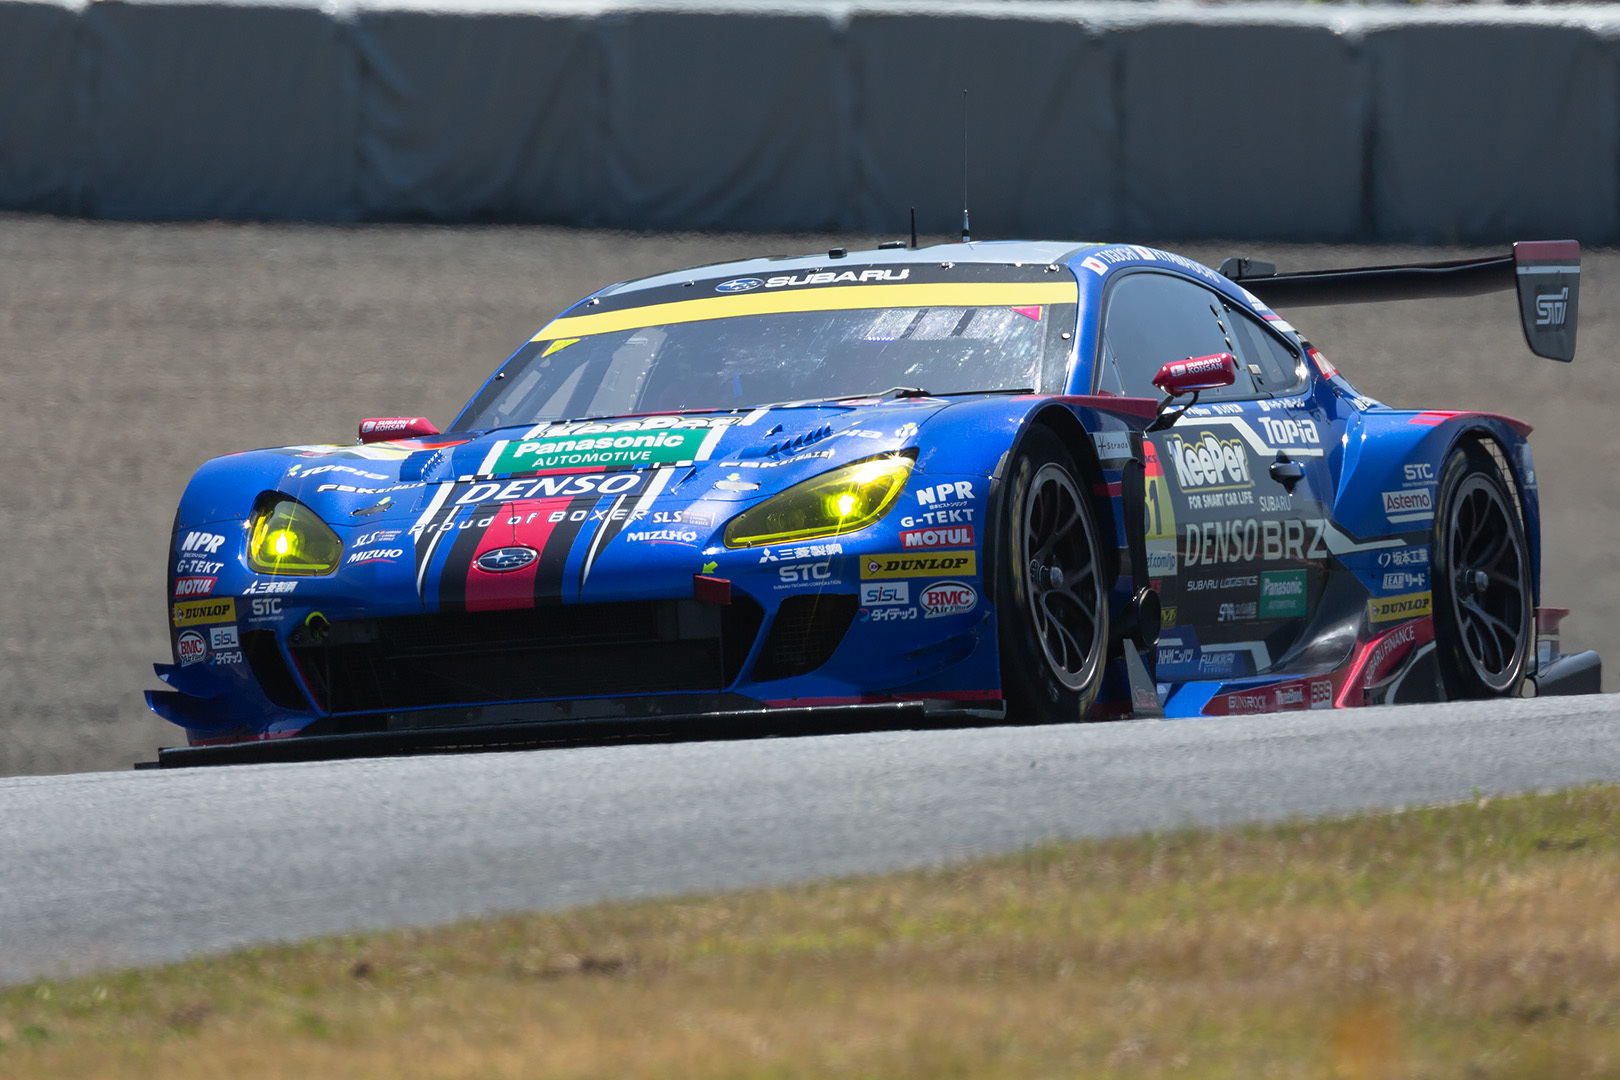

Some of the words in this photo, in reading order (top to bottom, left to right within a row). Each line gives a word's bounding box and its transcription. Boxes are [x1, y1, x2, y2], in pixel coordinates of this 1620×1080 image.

[764, 269, 910, 288] SUBARU
[1186, 357, 1222, 368] SUBARU
[1187, 363, 1223, 374] KOHSAN
[1258, 416, 1320, 444] Topia
[513, 433, 684, 458] Panasonic
[532, 451, 652, 468] AUTOMOTIVE
[1166, 434, 1251, 489] KeePer
[1404, 463, 1433, 480] STC
[456, 474, 641, 506] DENSO
[916, 481, 975, 506] NPR
[1188, 495, 1202, 509] FOR
[1203, 494, 1225, 509] SMART
[1225, 492, 1238, 507] CAR
[1238, 491, 1254, 506] LIFE
[1258, 495, 1292, 512] SUBARU
[1386, 493, 1430, 511] Astemo
[408, 515, 494, 537] Proud
[508, 512, 538, 526] of
[547, 508, 649, 523] BOXER
[653, 510, 683, 523] SLS
[900, 508, 974, 528] G-TEKT
[181, 531, 225, 553] NPR
[352, 530, 380, 548] SLS
[626, 530, 697, 542] MIZUHO
[905, 528, 971, 547] MOTUL
[1184, 518, 1259, 567] DENSO
[1262, 519, 1328, 561] BRZ
[346, 549, 403, 564] MIZUHO
[884, 557, 969, 572] DUNLOP
[1392, 549, 1429, 566] 坂本工業
[176, 560, 224, 574] G-TEKT
[778, 562, 831, 582] STC
[175, 579, 212, 596] MOTUL
[1187, 579, 1219, 592] SUBARU
[1220, 576, 1259, 589] LOGISTICS
[1263, 577, 1303, 596] Panasonic
[1405, 573, 1425, 587] リード
[252, 598, 282, 615] STC
[927, 590, 970, 606] BMC
[1380, 597, 1430, 615] DUNLOP
[185, 604, 230, 619] DUNLOP
[871, 607, 917, 621] ダイテック
[180, 638, 203, 655] BMC
[1384, 625, 1415, 656] FINANCE
